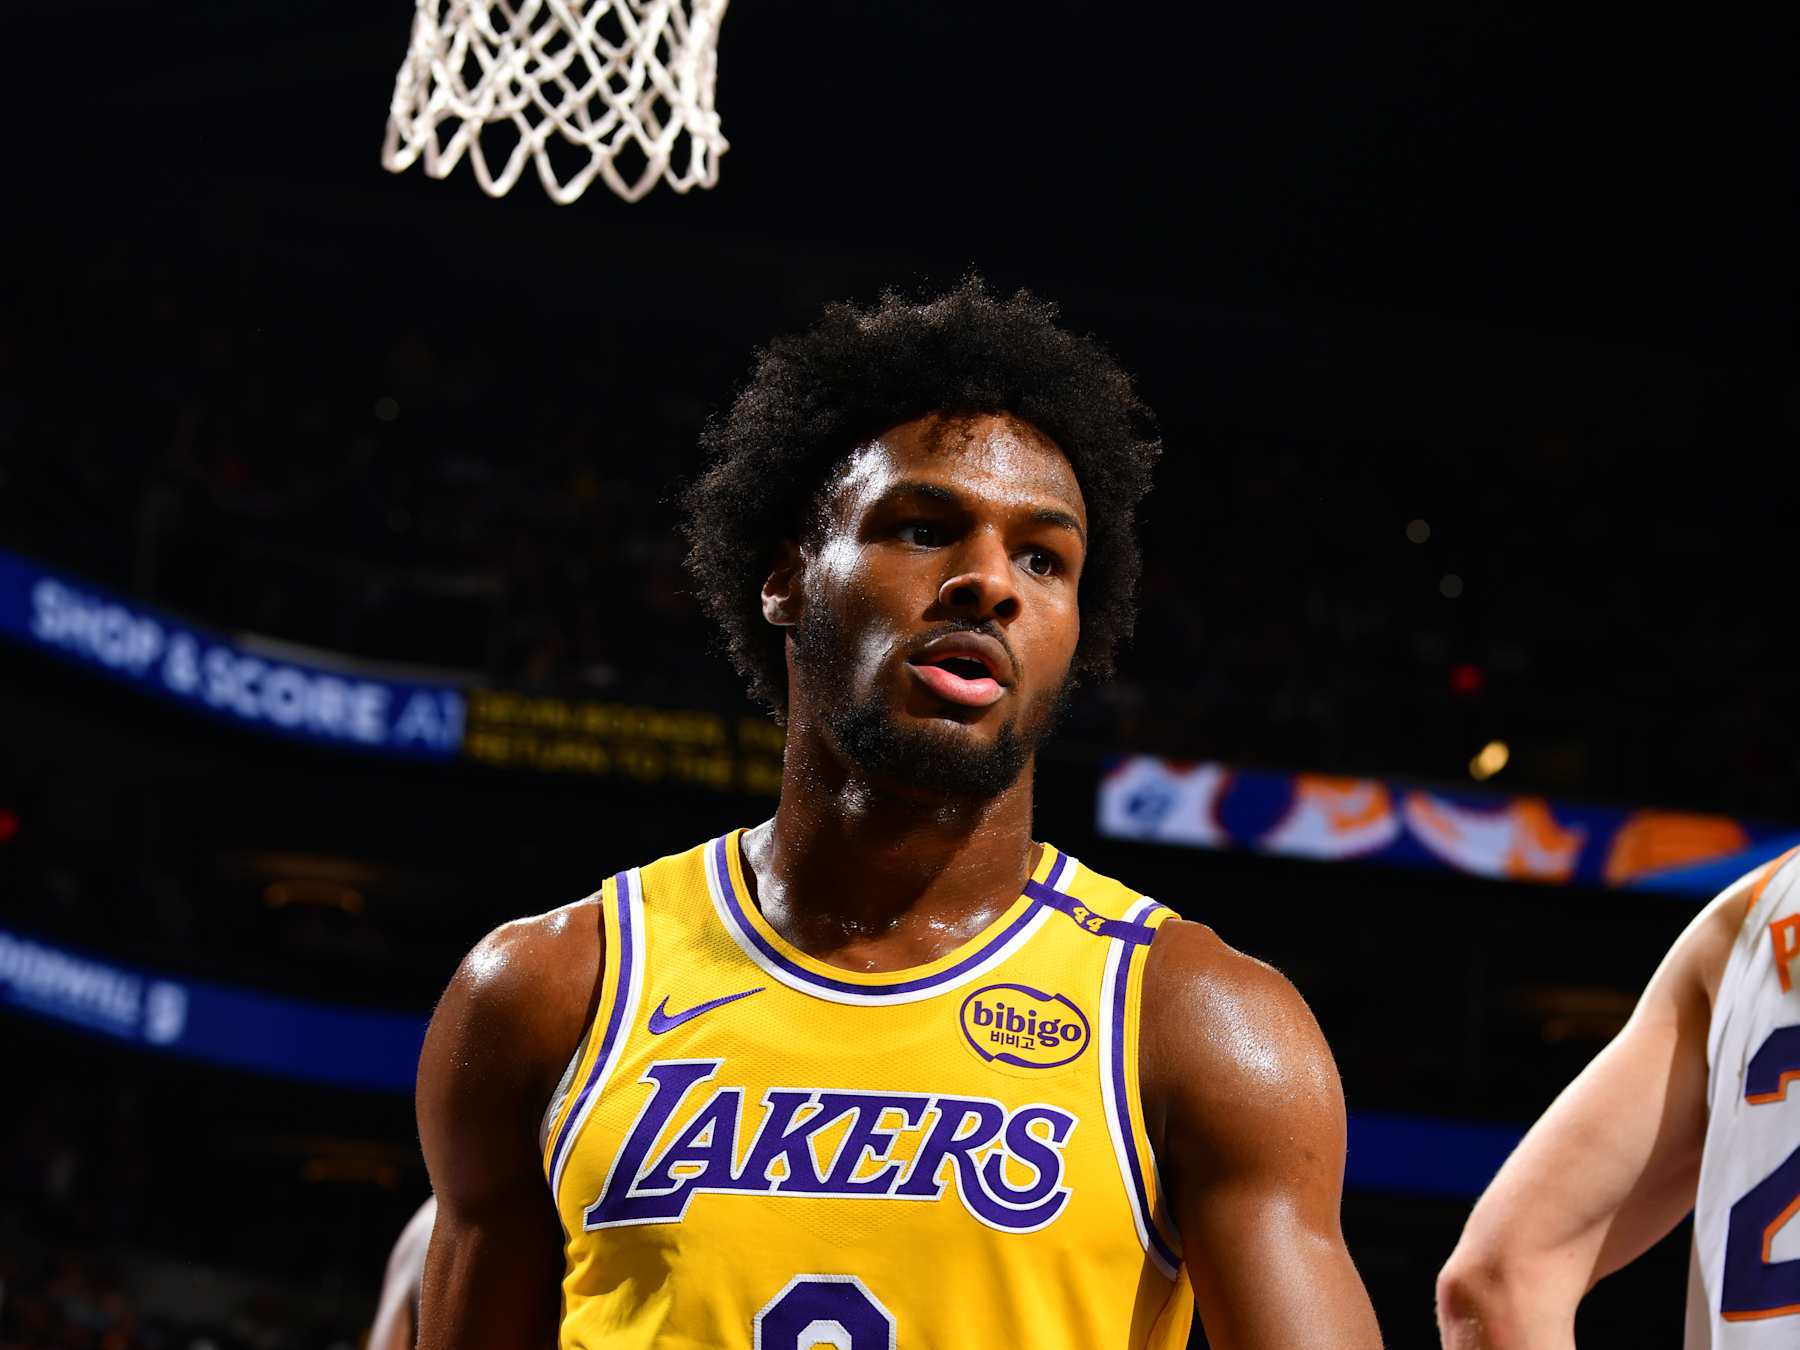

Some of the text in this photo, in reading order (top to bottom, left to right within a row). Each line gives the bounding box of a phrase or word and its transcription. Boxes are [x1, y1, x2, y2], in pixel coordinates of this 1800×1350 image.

[33, 580, 160, 673] SHOP
[203, 649, 389, 744] SCORE
[1072, 906, 1105, 932] 44
[973, 1001, 1082, 1047] bibigo
[990, 1030, 1036, 1051] 비비고
[582, 1057, 1080, 1234] LAKERS
